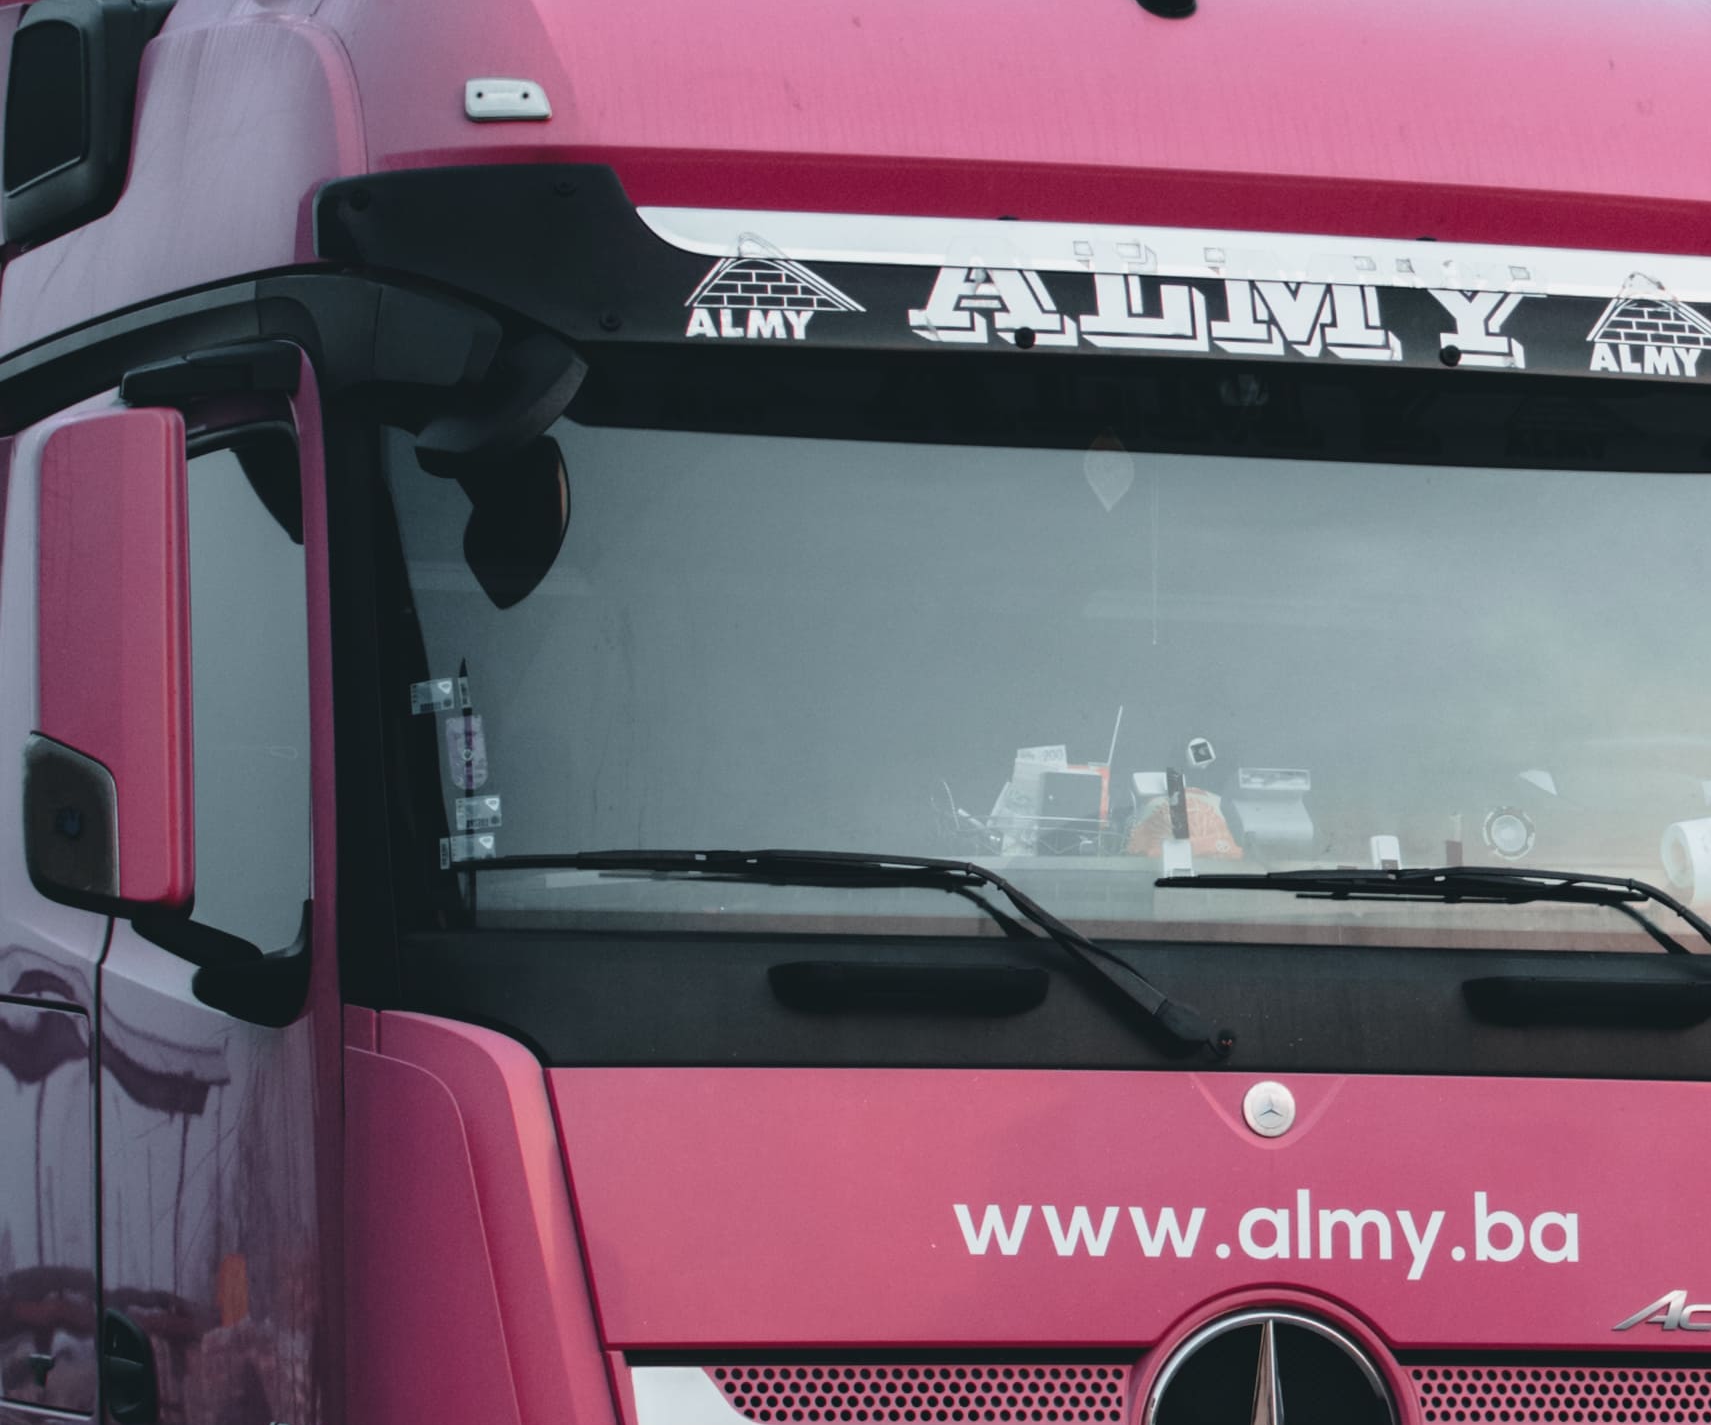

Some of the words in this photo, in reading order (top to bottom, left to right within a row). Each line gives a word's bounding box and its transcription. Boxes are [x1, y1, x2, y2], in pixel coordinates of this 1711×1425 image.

[685, 307, 815, 340] ALMY
[907, 246, 1547, 370] ALMY
[1589, 342, 1702, 377] ALMY
[953, 1189, 1580, 1280] www.almy.ba
